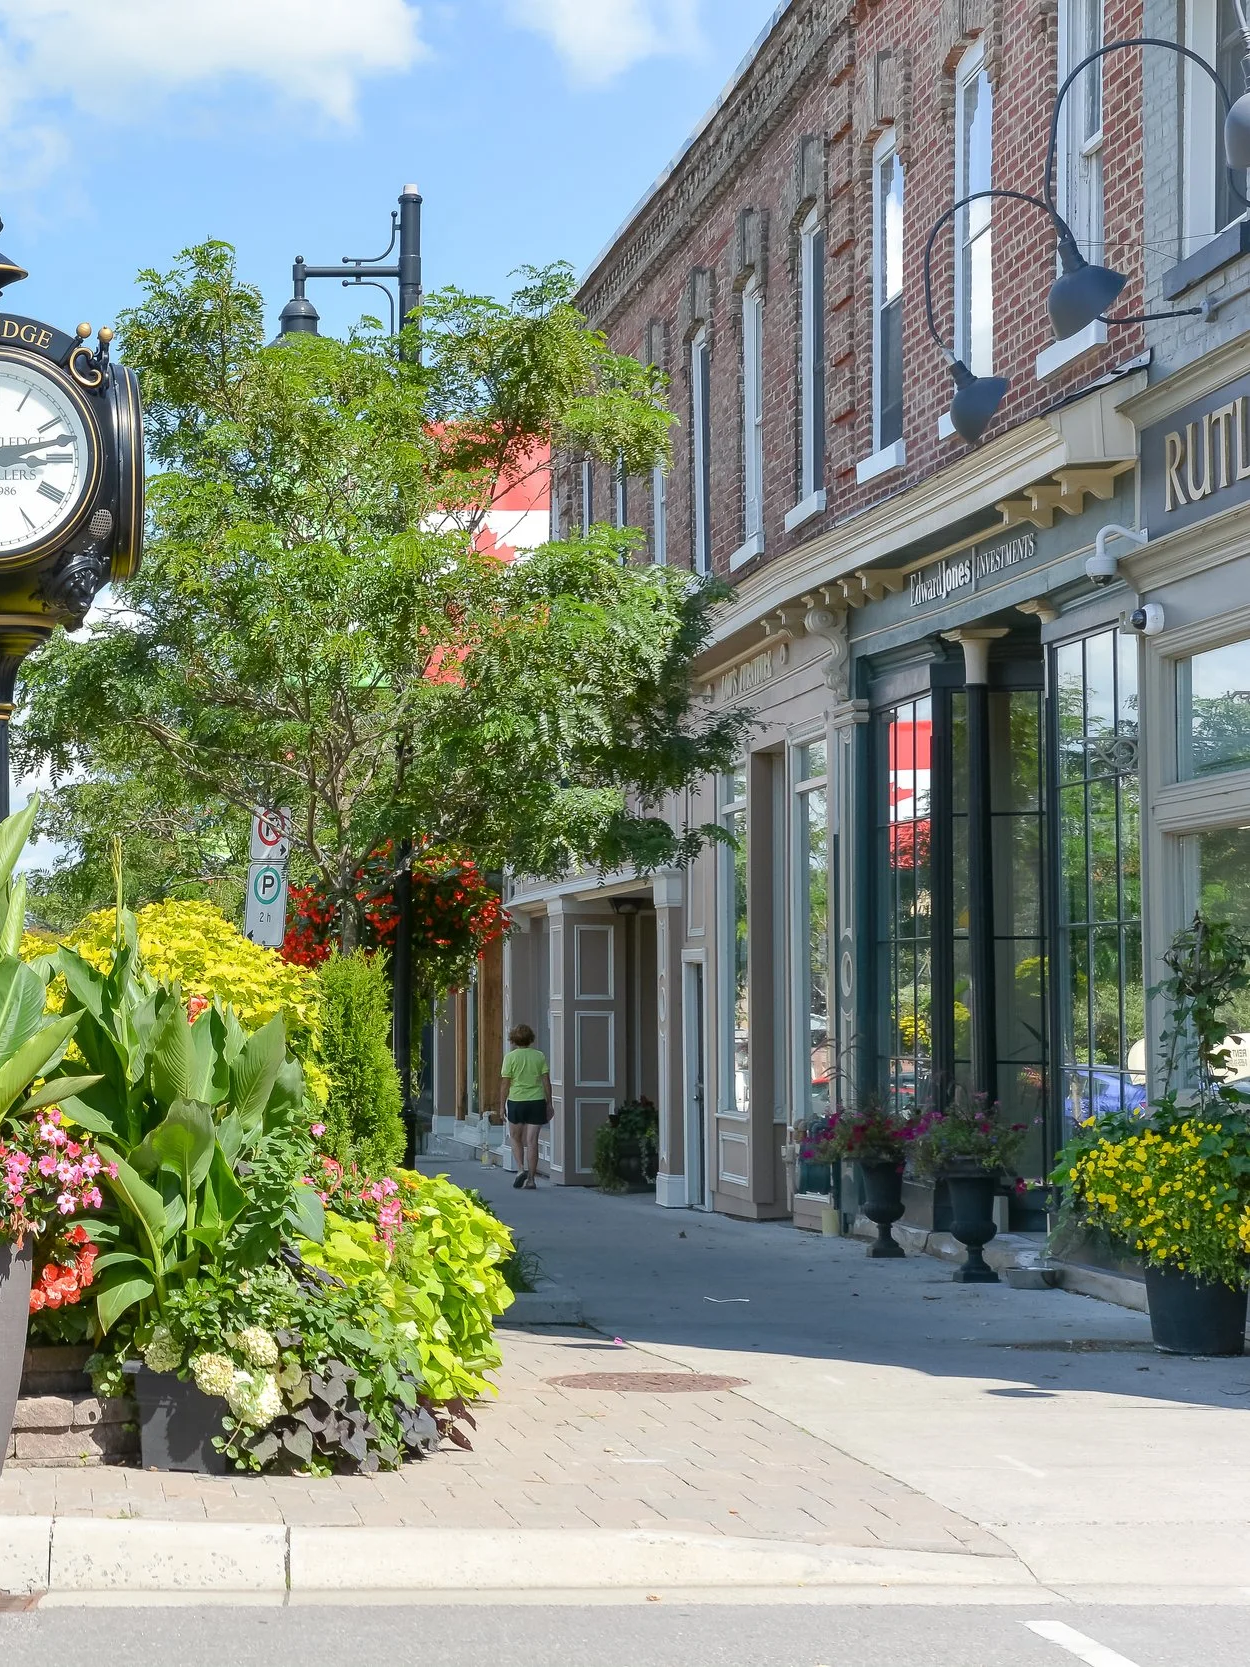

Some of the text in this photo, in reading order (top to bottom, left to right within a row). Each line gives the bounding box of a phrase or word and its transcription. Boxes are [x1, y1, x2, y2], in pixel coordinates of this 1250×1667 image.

[16, 387, 33, 412] I
[36, 415, 63, 434] II
[1164, 396, 1250, 512] RUTL
[976, 532, 1034, 579] INVESTMENTS
[262, 875, 274, 894] P
